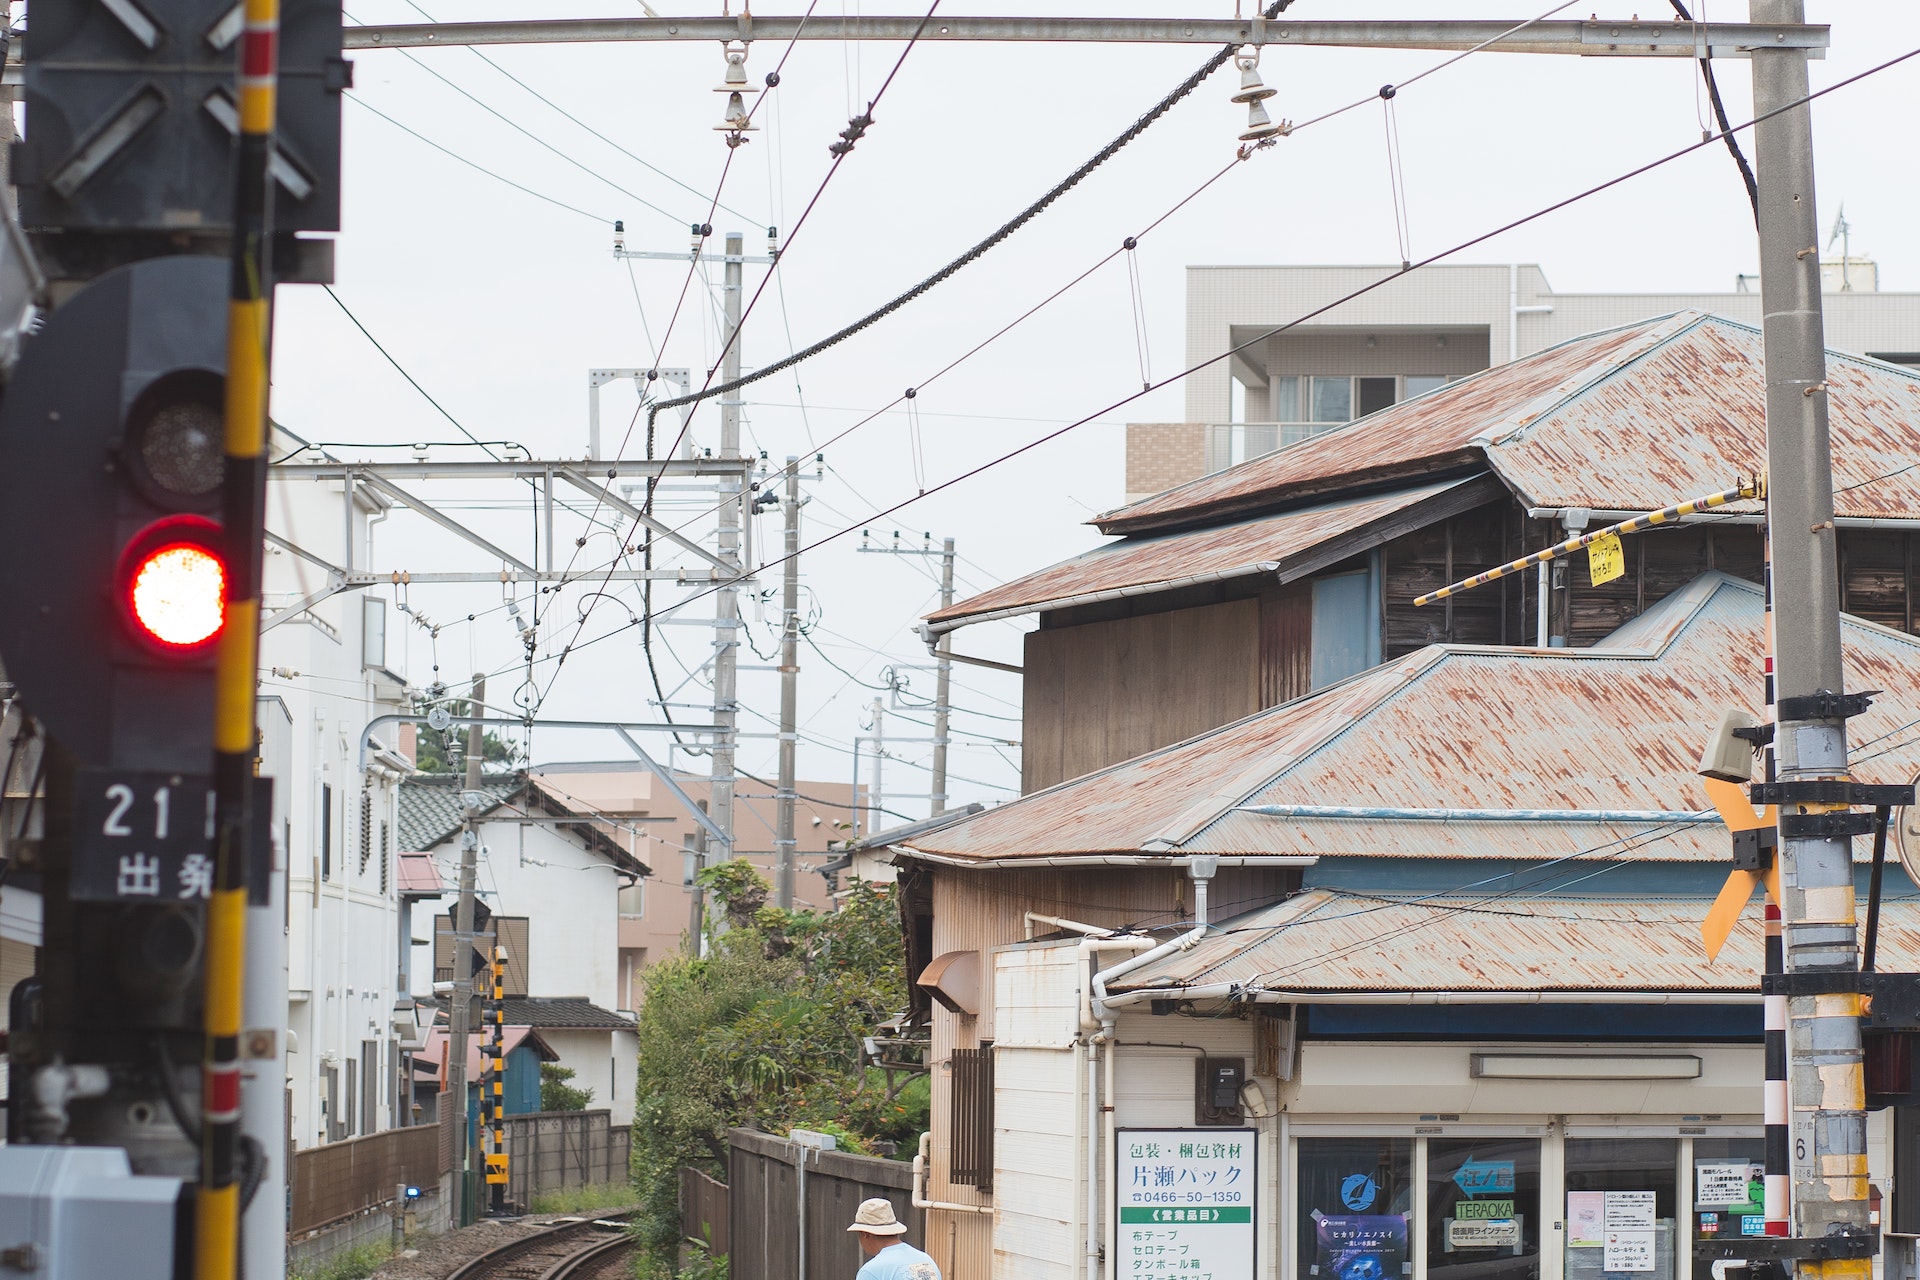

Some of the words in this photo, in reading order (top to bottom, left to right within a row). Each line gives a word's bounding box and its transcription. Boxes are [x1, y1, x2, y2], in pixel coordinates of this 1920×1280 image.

[103, 784, 216, 839] 21
[1129, 1143, 1242, 1159] 包装・梱包資材
[1132, 1165, 1242, 1187] 片瀬パック
[1463, 1168, 1514, 1188] 江ノ島
[1144, 1191, 1242, 1203] 0466-50-1350
[1457, 1202, 1514, 1218] TERAOKA
[1132, 1231, 1178, 1241] 布テープ
[1332, 1231, 1393, 1239] ヒカリノエノスイ
[1132, 1244, 1190, 1255] セロテープ
[1132, 1259, 1201, 1270] ダンボール箱
